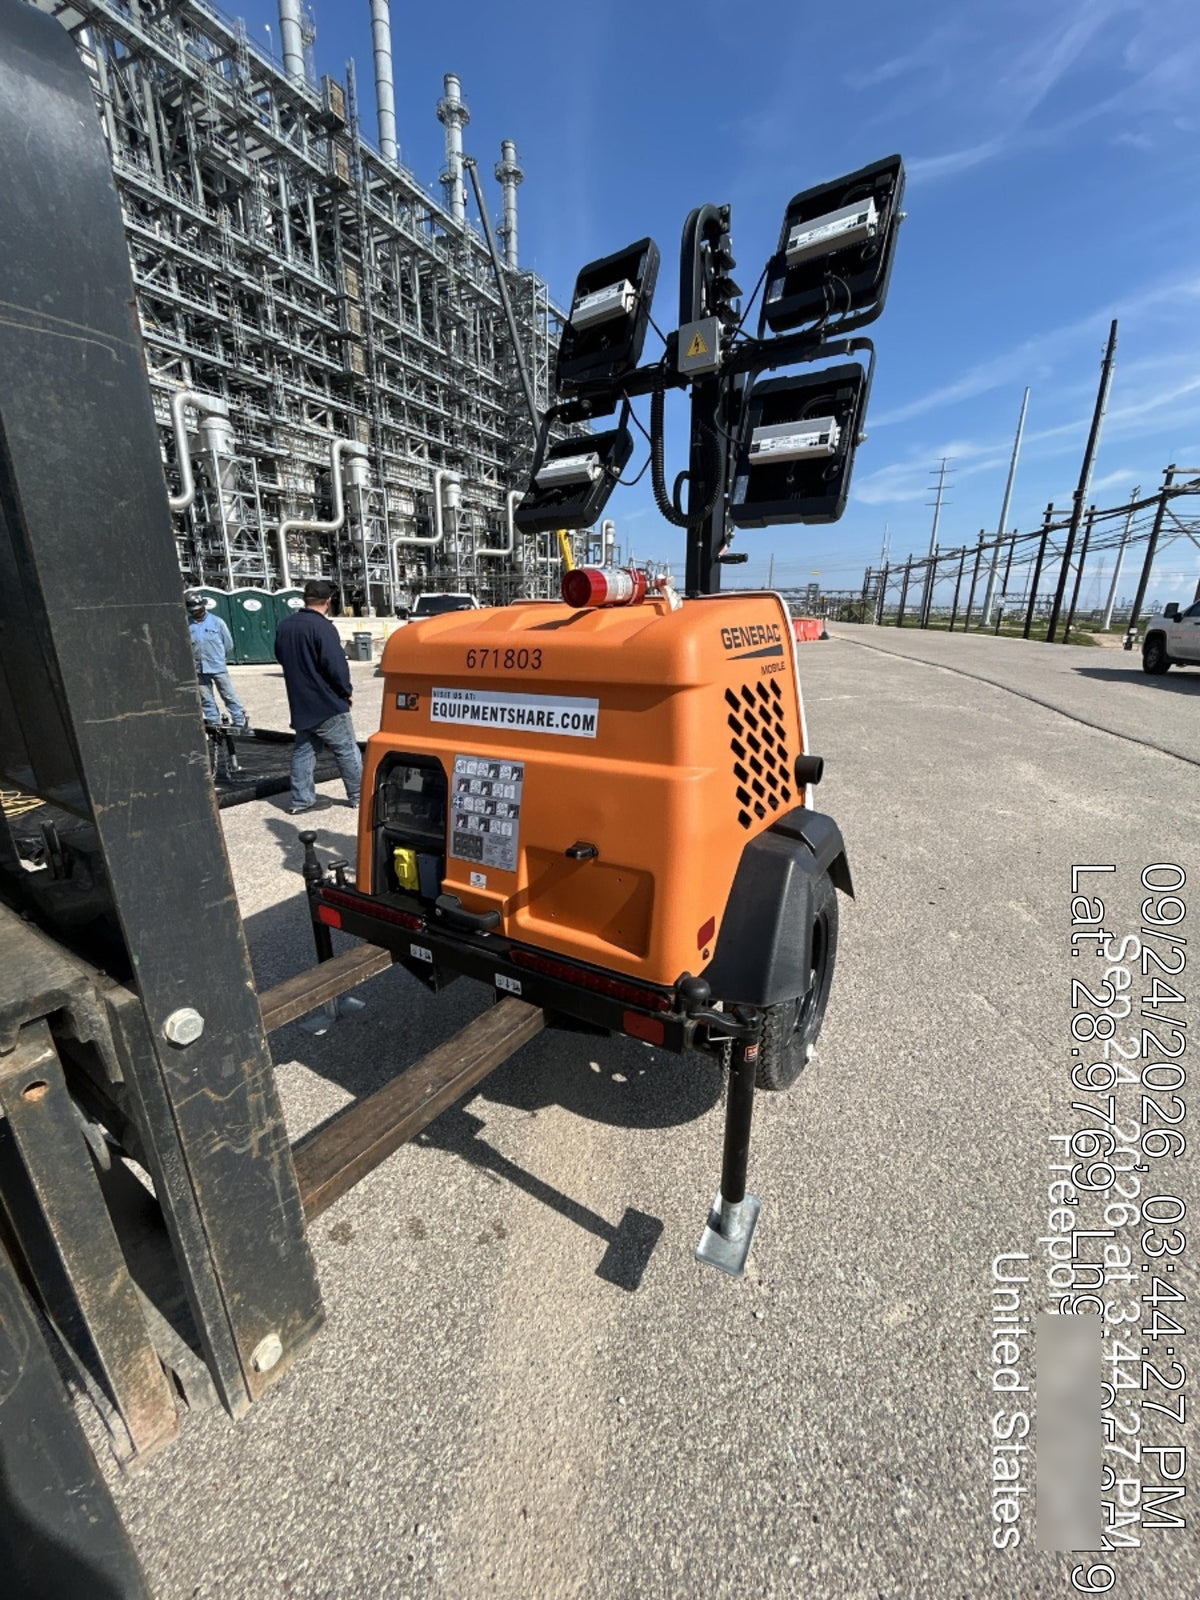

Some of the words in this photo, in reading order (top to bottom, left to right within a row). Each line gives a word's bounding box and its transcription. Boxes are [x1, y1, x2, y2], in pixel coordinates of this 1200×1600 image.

[720, 623, 781, 650] GENERAC
[466, 648, 543, 670] 671803
[760, 661, 786, 676] MOBILE
[433, 690, 451, 699] VISIT
[453, 692, 462, 700] US
[432, 701, 595, 732] EQUIPMENTSHARE.COM
